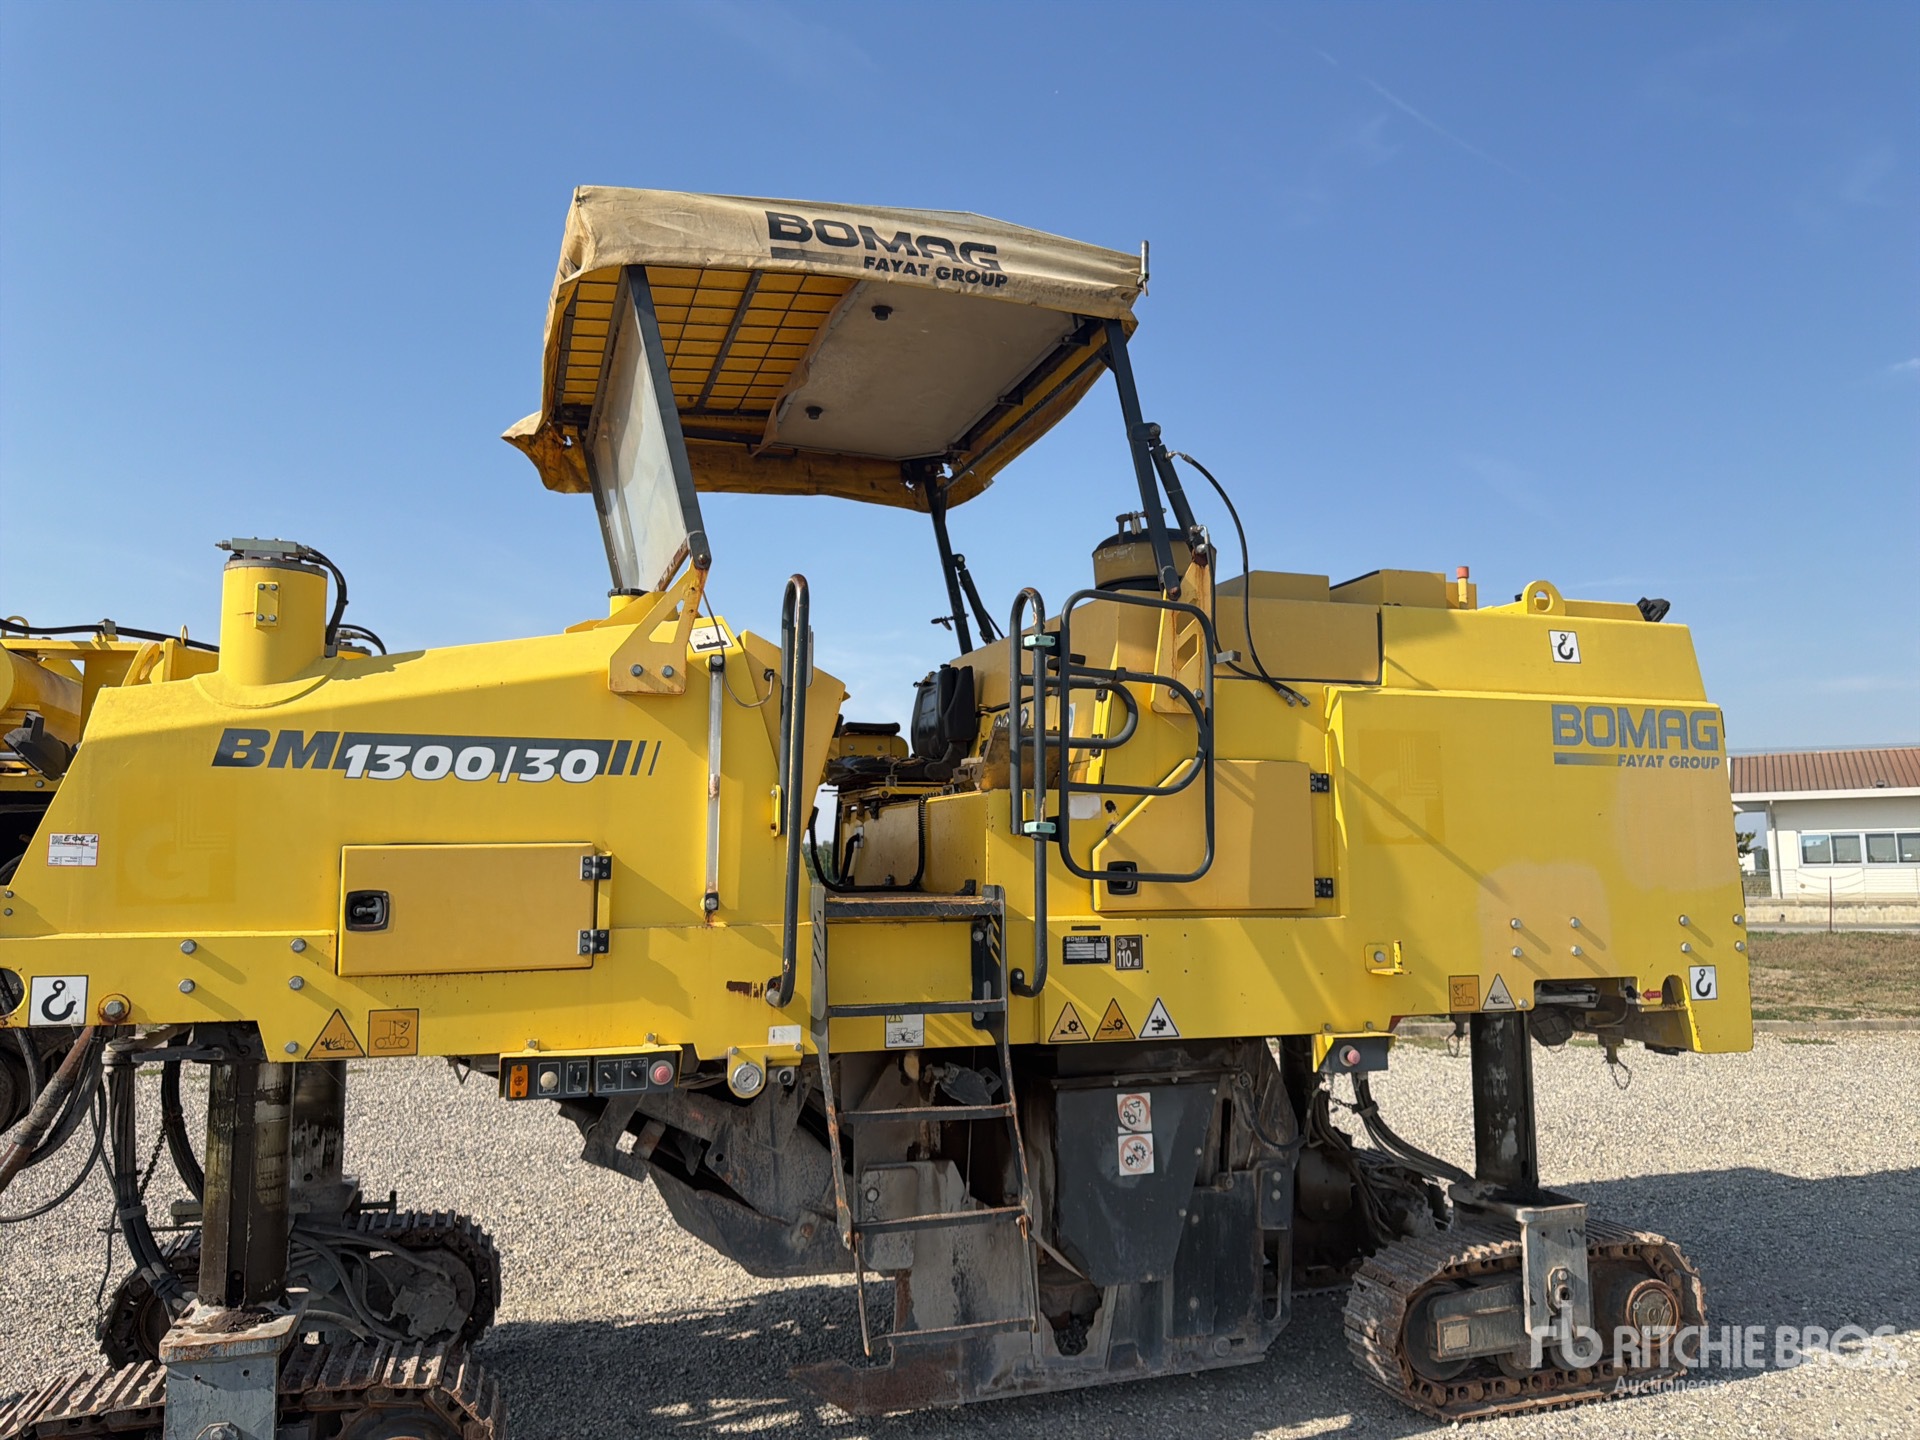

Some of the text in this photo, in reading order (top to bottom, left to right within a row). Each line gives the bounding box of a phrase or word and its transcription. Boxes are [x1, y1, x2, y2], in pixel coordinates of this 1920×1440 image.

[765, 210, 1003, 271] BOMAG
[863, 256, 1008, 288] FAYAT GROUP
[1551, 704, 1719, 751] BOMAG
[211, 728, 341, 769] BM
[1617, 754, 1720, 770] FAYAT GROUP
[1117, 950, 1132, 967] 110
